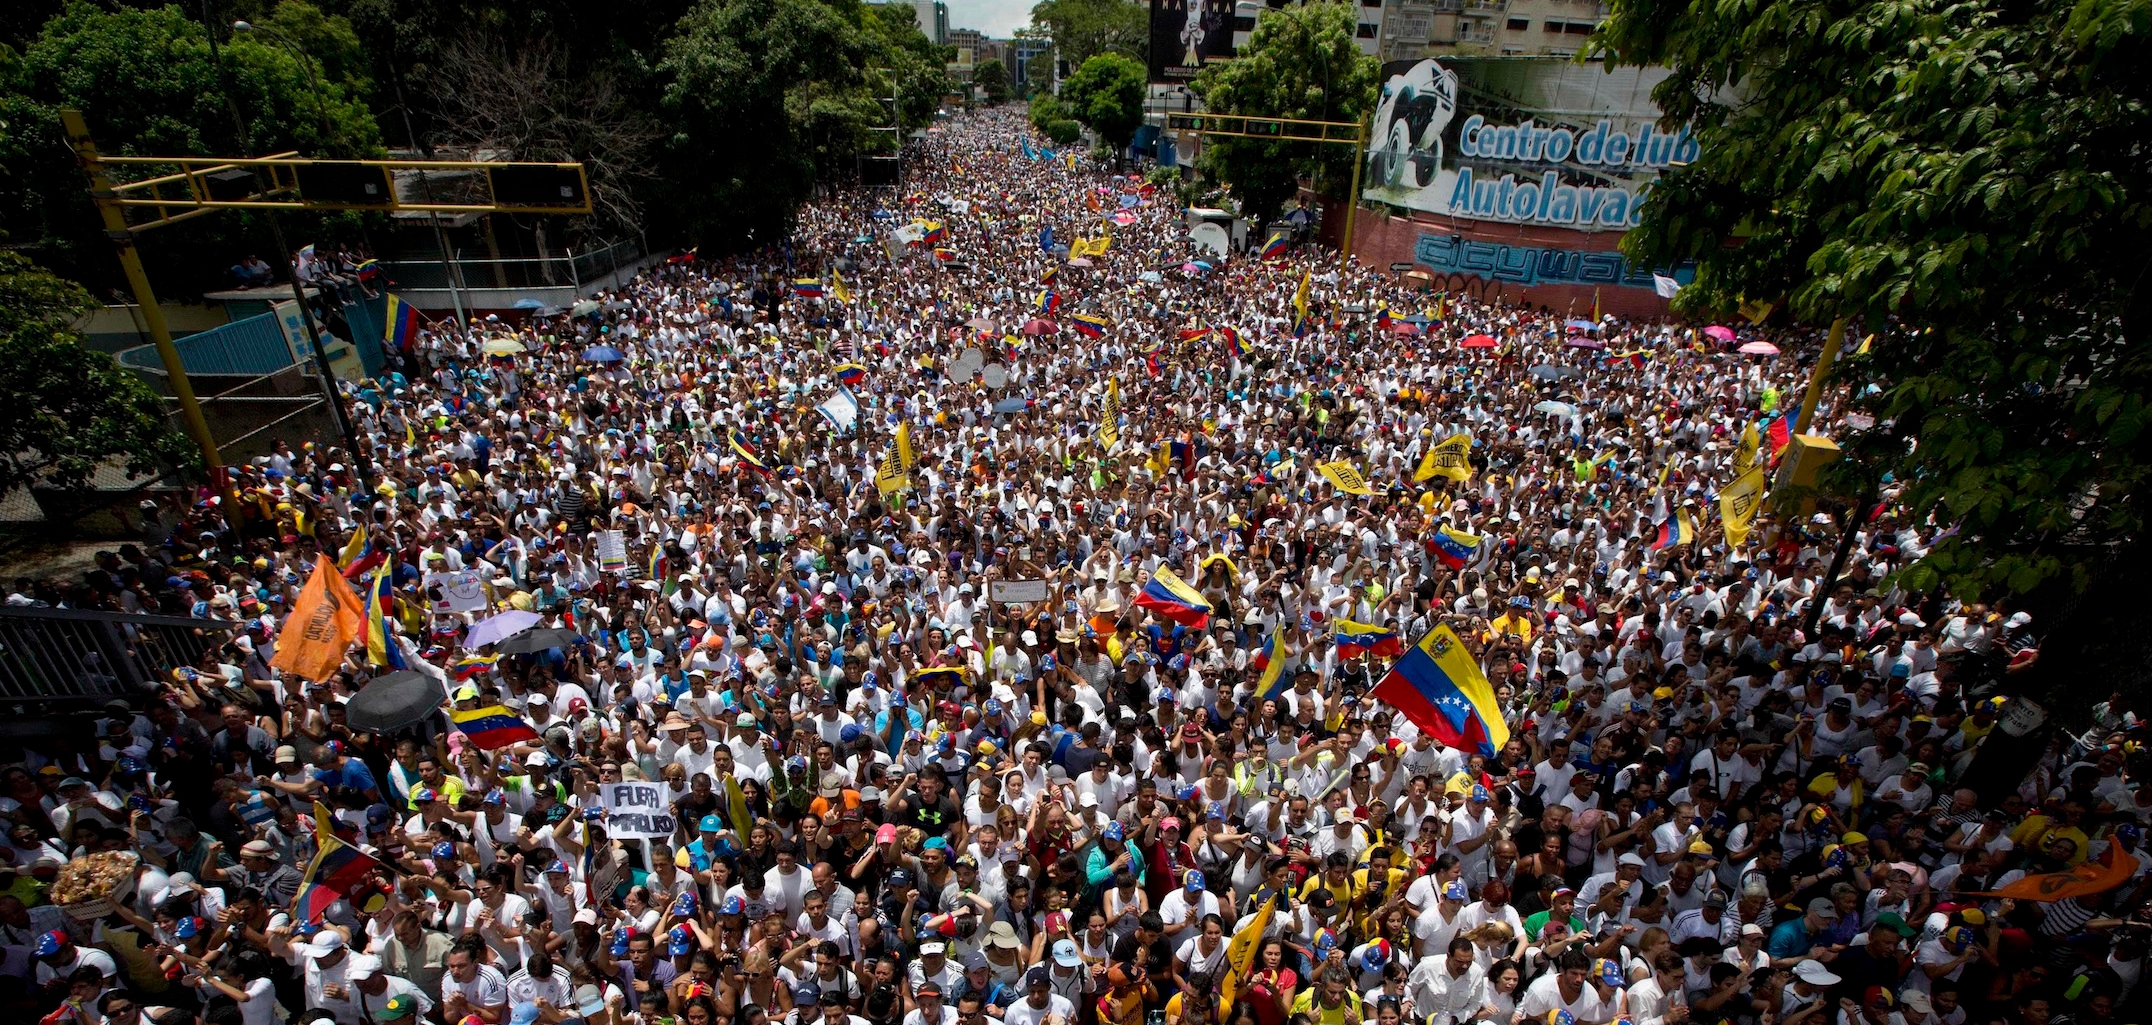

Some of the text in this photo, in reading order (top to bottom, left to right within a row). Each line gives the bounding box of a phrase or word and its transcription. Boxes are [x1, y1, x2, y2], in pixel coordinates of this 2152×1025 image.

[1162, 0, 1231, 13] MAUMA
[1460, 115, 1701, 168] Centro de lub
[614, 786, 660, 808] FUERA
